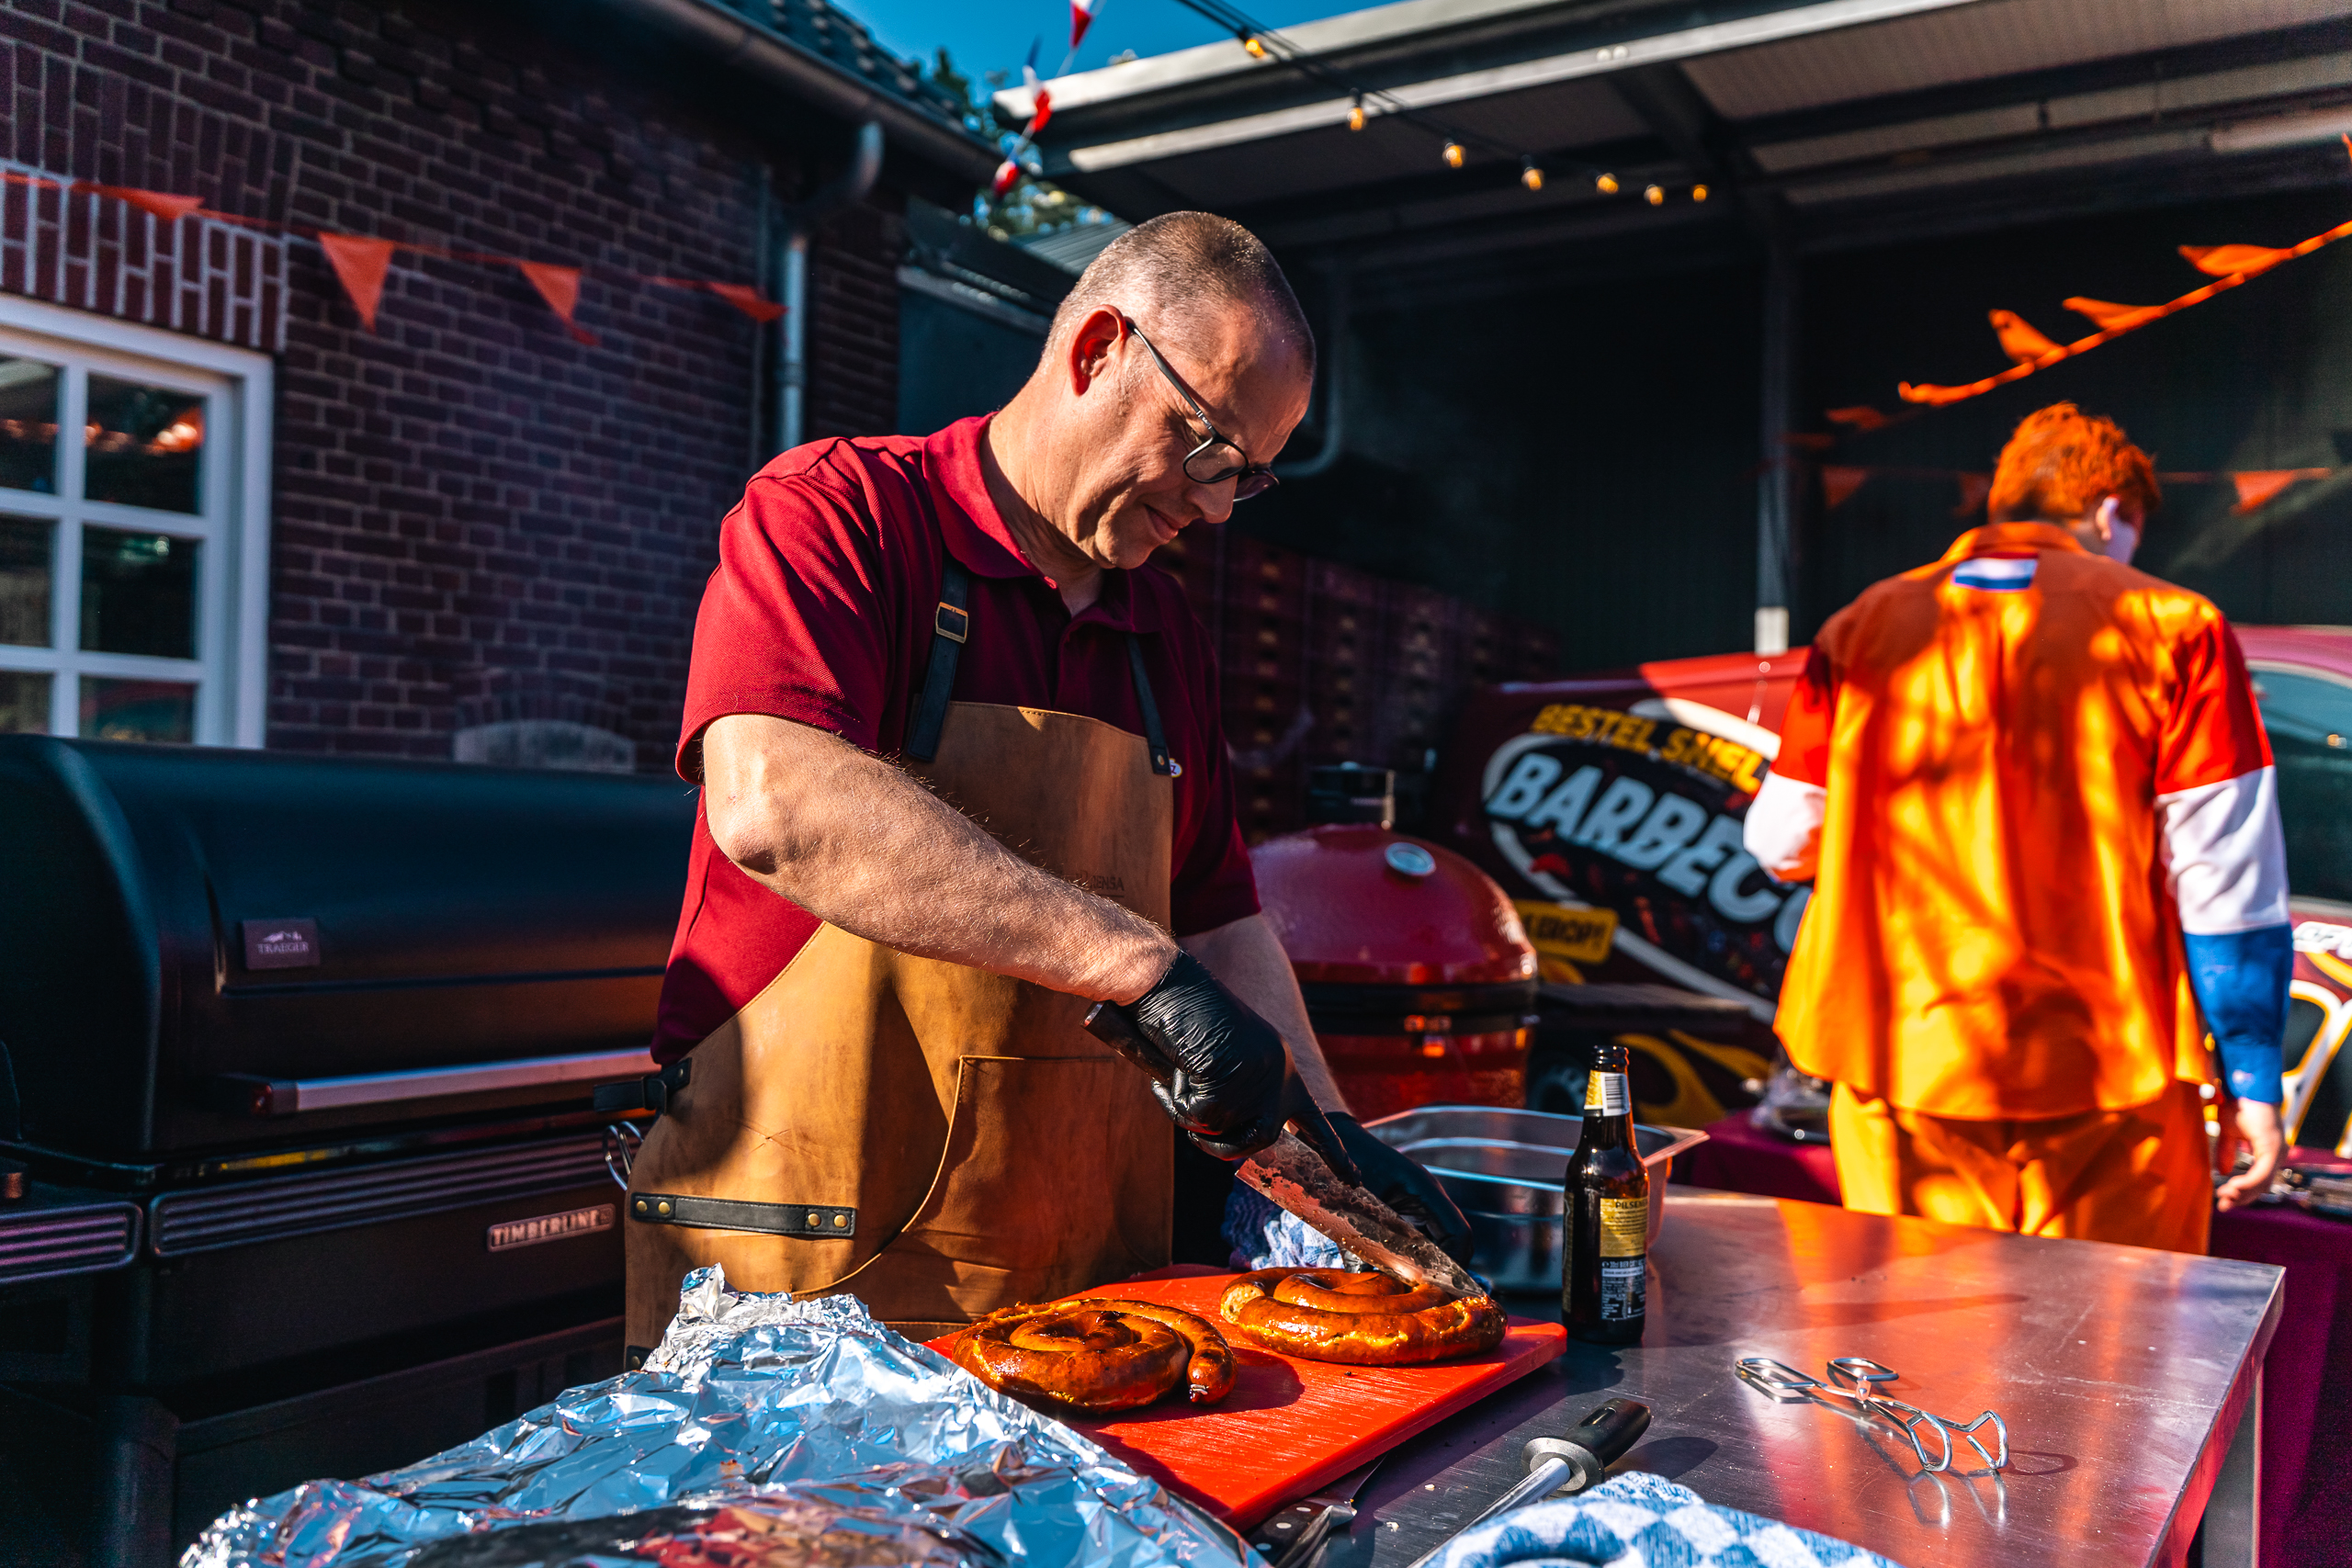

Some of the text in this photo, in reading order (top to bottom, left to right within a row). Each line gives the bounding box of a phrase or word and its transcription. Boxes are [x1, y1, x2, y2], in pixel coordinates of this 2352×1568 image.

[1531, 704, 1657, 754] BESTEL
[257, 942, 309, 954] TRAEGER
[493, 1210, 598, 1247] TIMBERLINE
